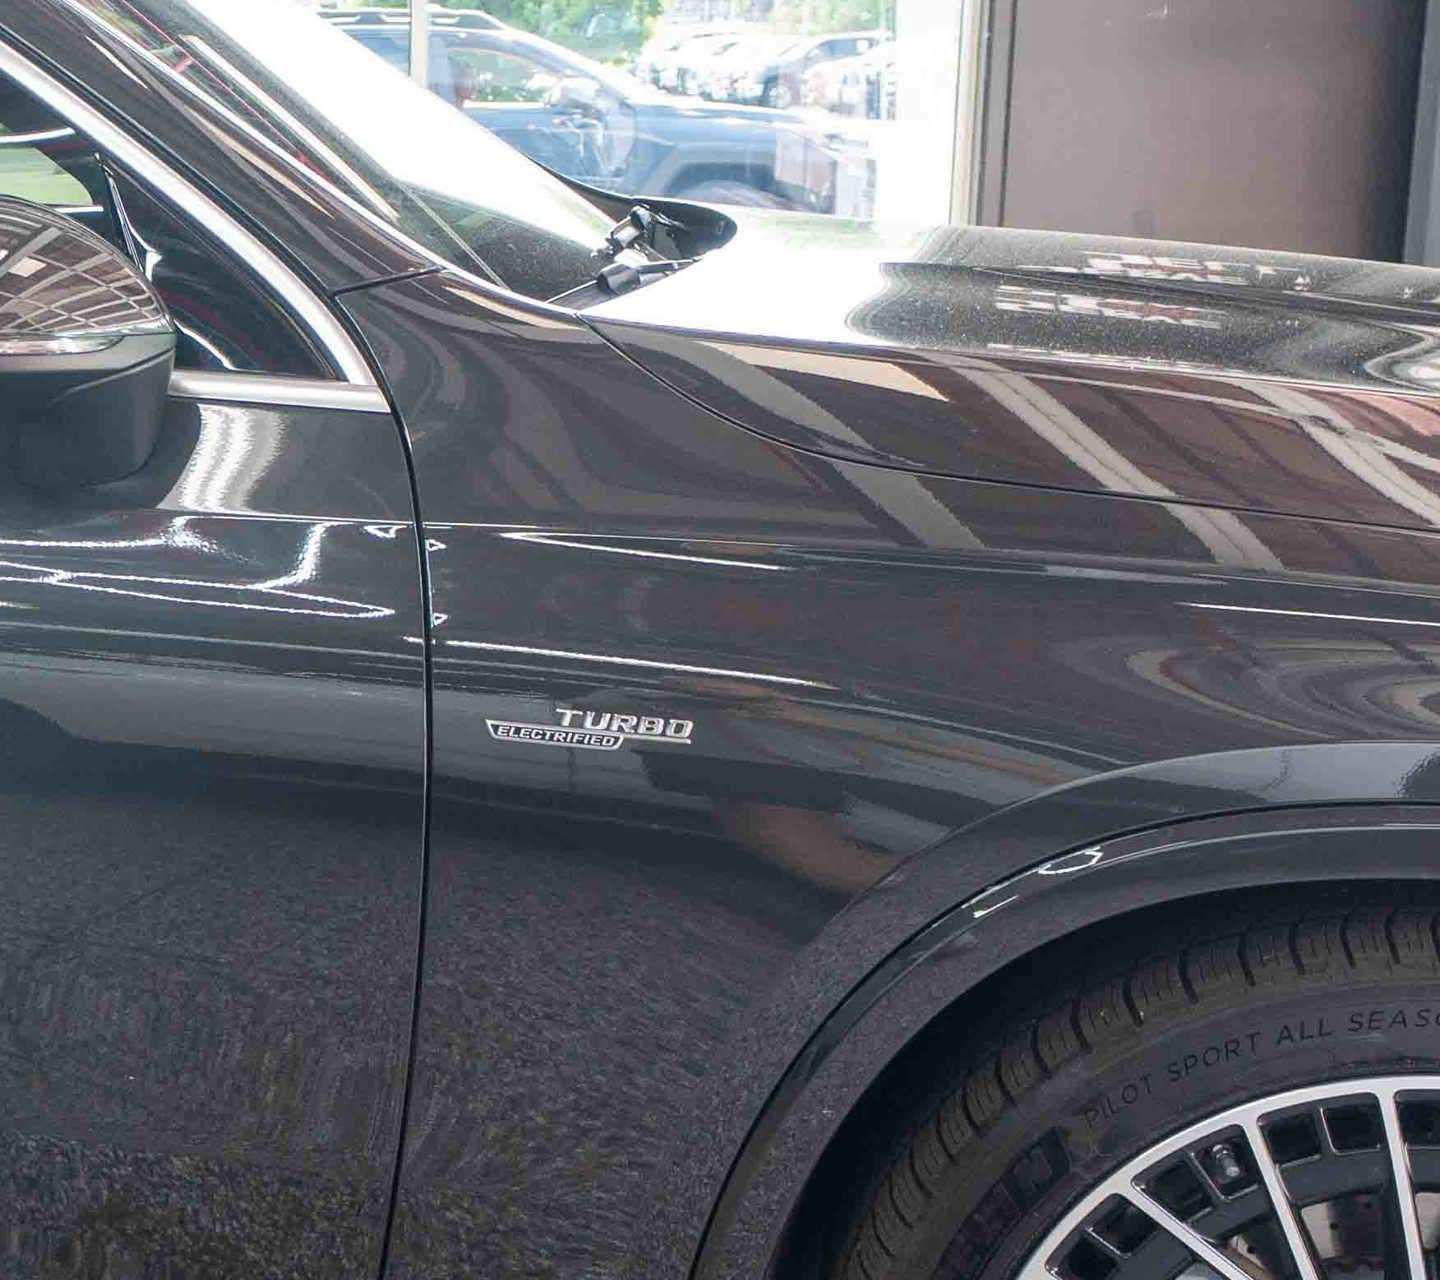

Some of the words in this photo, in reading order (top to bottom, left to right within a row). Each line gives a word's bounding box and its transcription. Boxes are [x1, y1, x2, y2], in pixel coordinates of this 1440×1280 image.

[496, 724, 616, 747] ELECTRIFIED
[555, 707, 694, 739] TURBO
[1083, 1072, 1154, 1130] PILOT
[1166, 1031, 1259, 1083] SPORT
[1275, 1015, 1333, 1046] ALL
